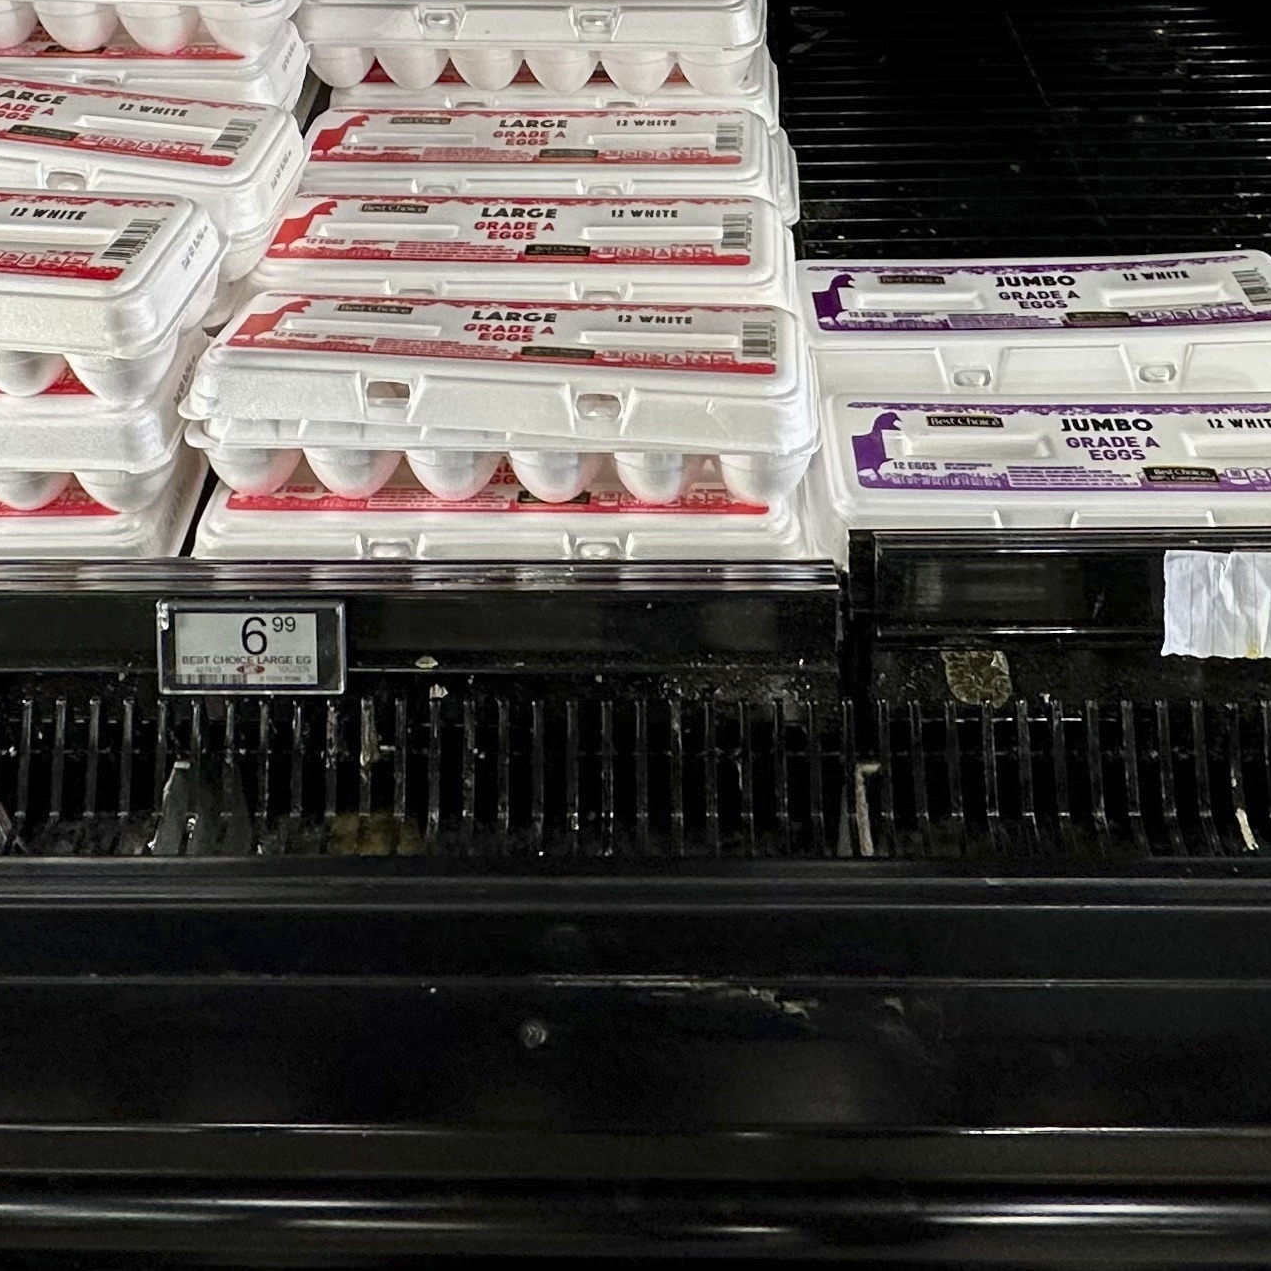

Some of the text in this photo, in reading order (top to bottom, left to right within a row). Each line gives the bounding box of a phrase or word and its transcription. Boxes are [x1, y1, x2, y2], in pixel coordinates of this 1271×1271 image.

[42, 107, 56, 117] A
[118, 102, 137, 112] 12
[140, 104, 189, 119] WHITE
[499, 119, 568, 129] LARGE
[9, 206, 29, 217] 12
[32, 208, 88, 222] WHITE
[480, 207, 679, 219] LARGE 12 WHITE
[473, 221, 556, 231] GRADE A
[486, 231, 536, 240] EGGS
[995, 269, 1190, 287] JUMBO 12 WHITE
[998, 289, 1081, 301] GRADE A
[1018, 299, 1069, 310] EGGS
[471, 310, 693, 325] LARGE 12 WHITE
[463, 323, 555, 333] GRADE A
[477, 332, 534, 343] EGGS
[930, 417, 955, 428] Best
[956, 417, 1002, 428] Choice
[1060, 418, 1154, 433] JUMBO
[1206, 418, 1225, 429] 12
[1064, 436, 1160, 449] GRADE A
[1088, 449, 1147, 462] EGGS
[240, 616, 297, 656] 6 99
[182, 655, 312, 665] BEST CHOICE LARGE EG
